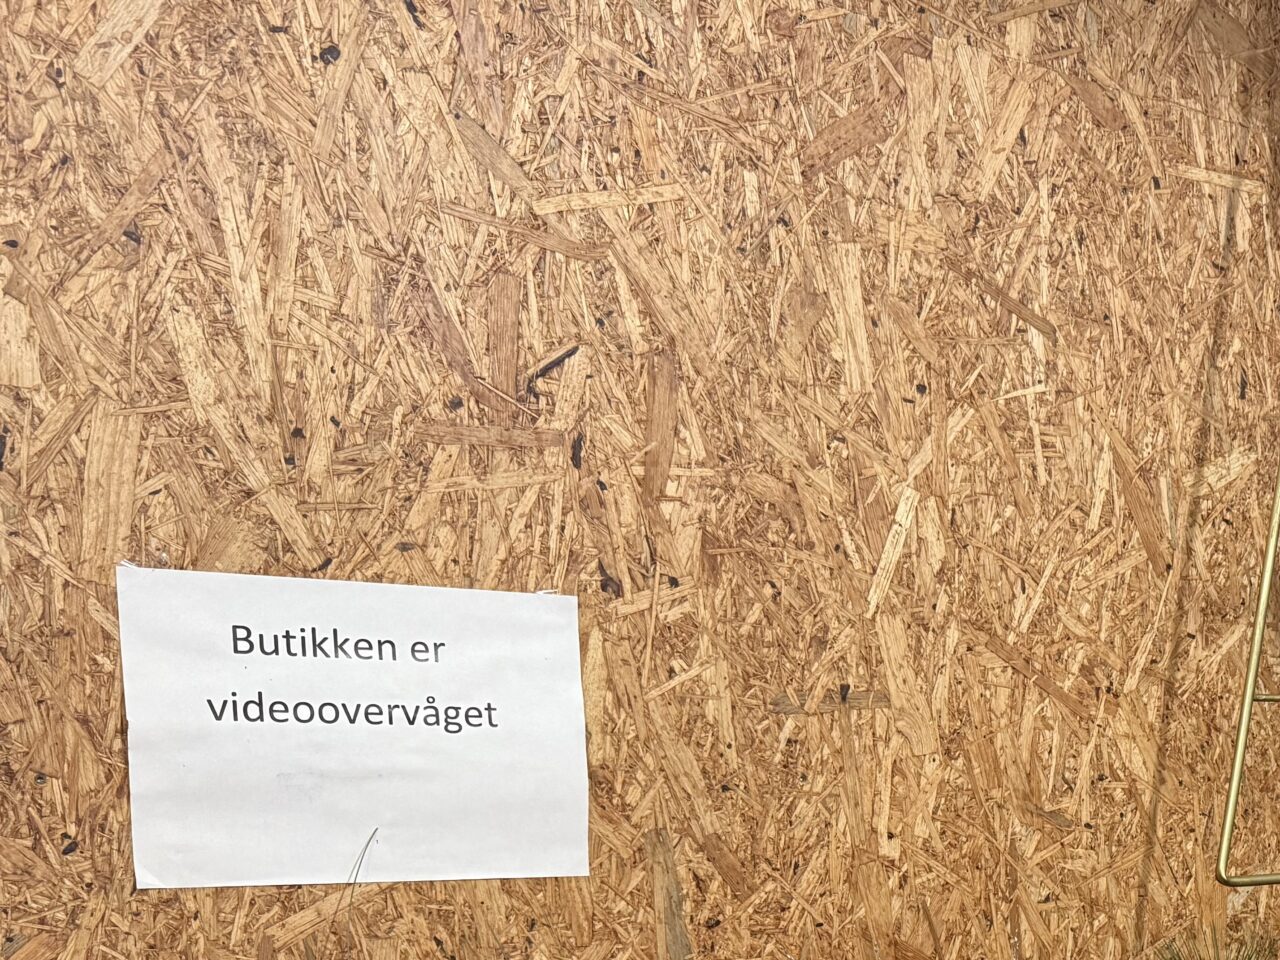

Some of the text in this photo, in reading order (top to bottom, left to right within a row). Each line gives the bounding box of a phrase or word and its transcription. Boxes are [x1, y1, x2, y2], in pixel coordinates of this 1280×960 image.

[231, 624, 446, 663] Butikken er
[206, 690, 500, 734] videoovervåget
